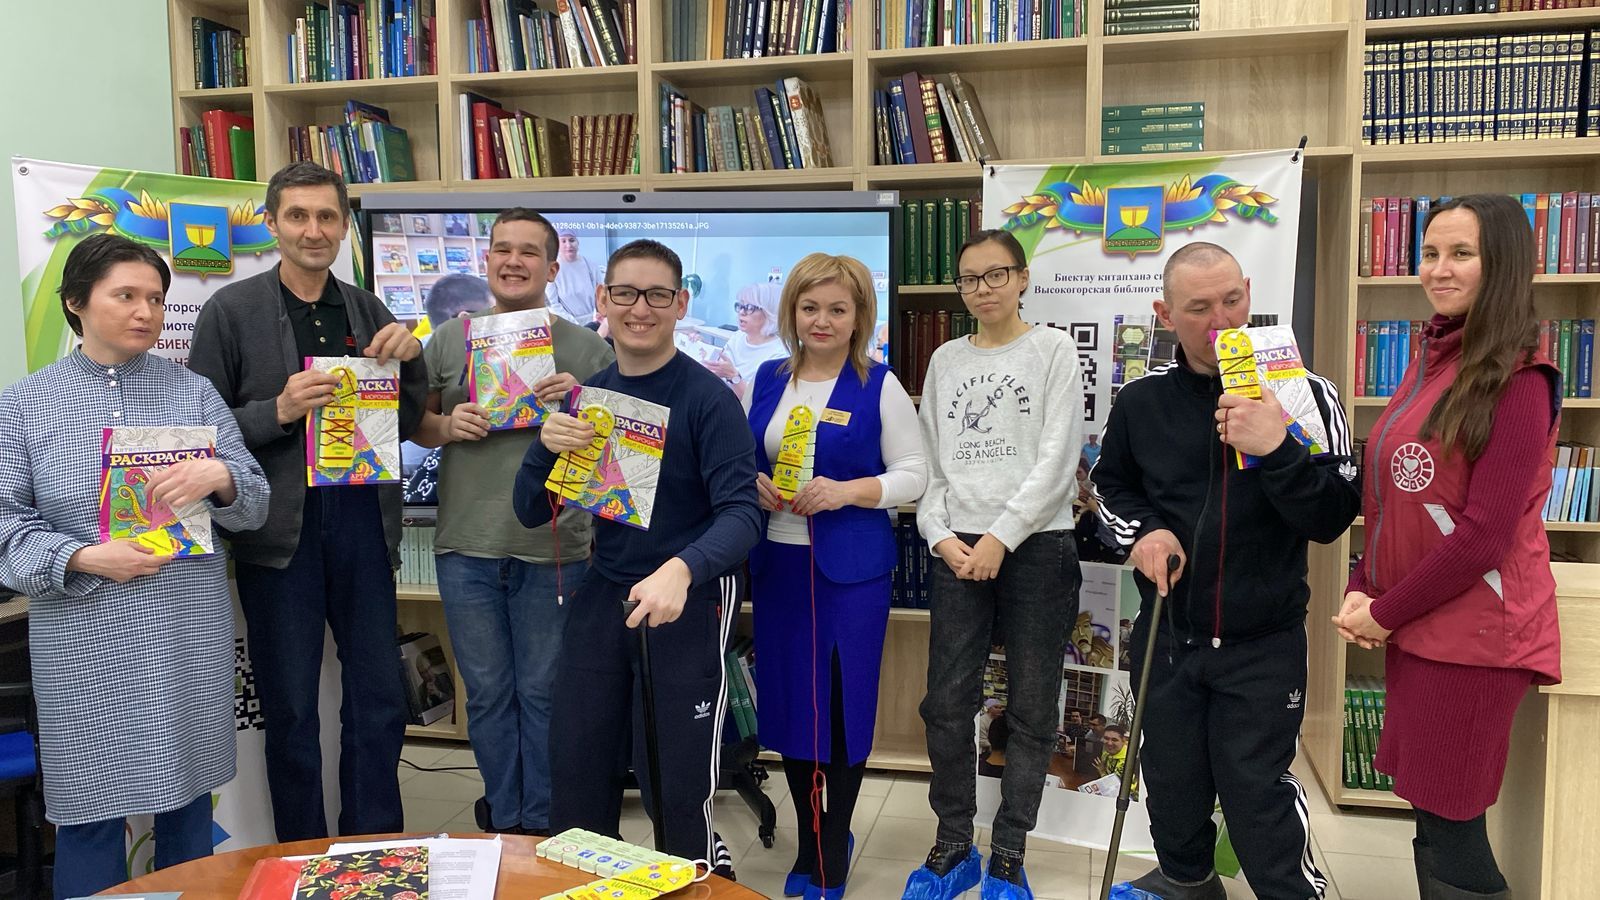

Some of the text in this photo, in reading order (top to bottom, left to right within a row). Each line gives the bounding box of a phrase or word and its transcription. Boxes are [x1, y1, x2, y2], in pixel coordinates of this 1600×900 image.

[1055, 273, 1095, 283] Биектау
[1034, 286, 1110, 295] Высокогорская
[471, 328, 546, 349] РАСКРАСКА
[1255, 350, 1296, 362] РАСКА
[948, 373, 1030, 419] PACIFIC FLEET
[615, 416, 660, 438] РАСКА
[985, 438, 1005, 447] BEACH
[110, 450, 208, 466] РАСКРАСКА
[953, 446, 1017, 460] LOS ANGELES
